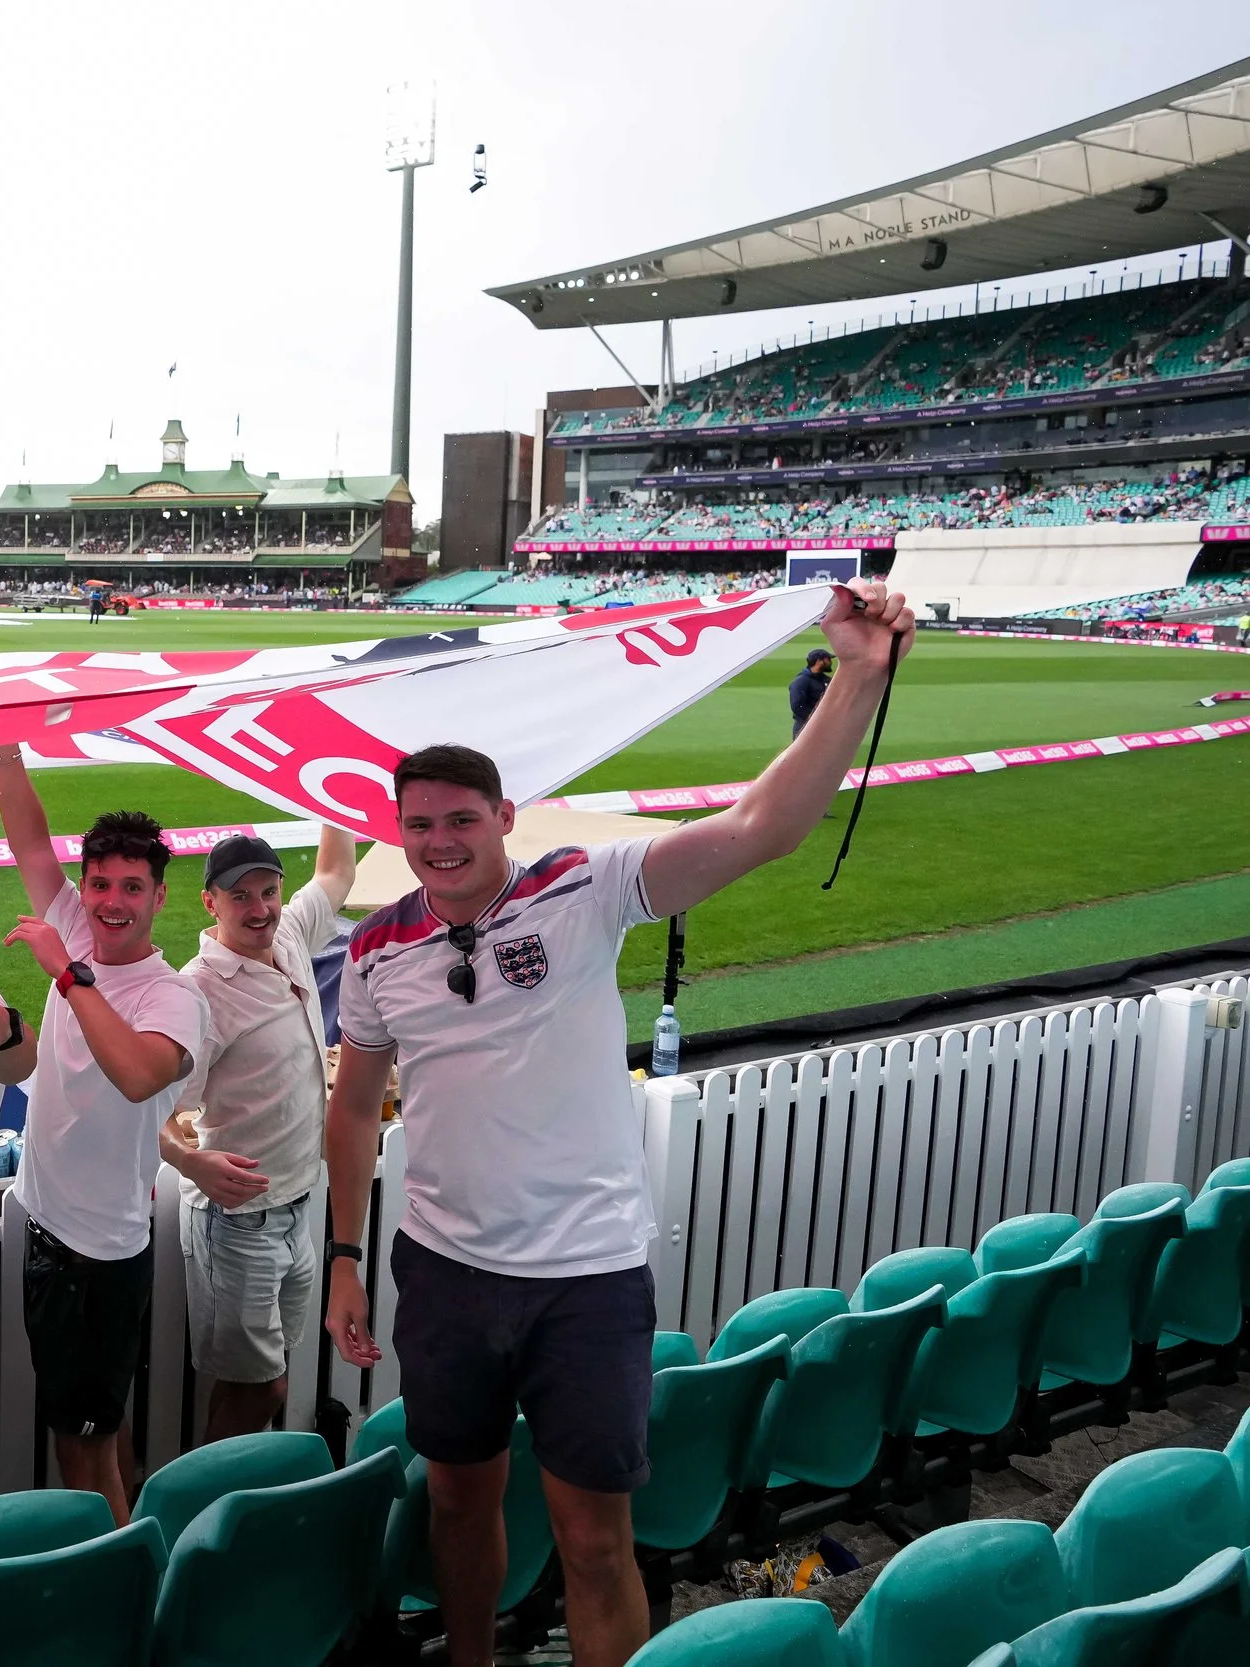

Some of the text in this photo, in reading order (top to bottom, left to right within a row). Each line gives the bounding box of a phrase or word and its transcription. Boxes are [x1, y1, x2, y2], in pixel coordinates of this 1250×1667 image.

[829, 209, 971, 250] M A NOBLE STAND
[640, 791, 696, 807] bet365
